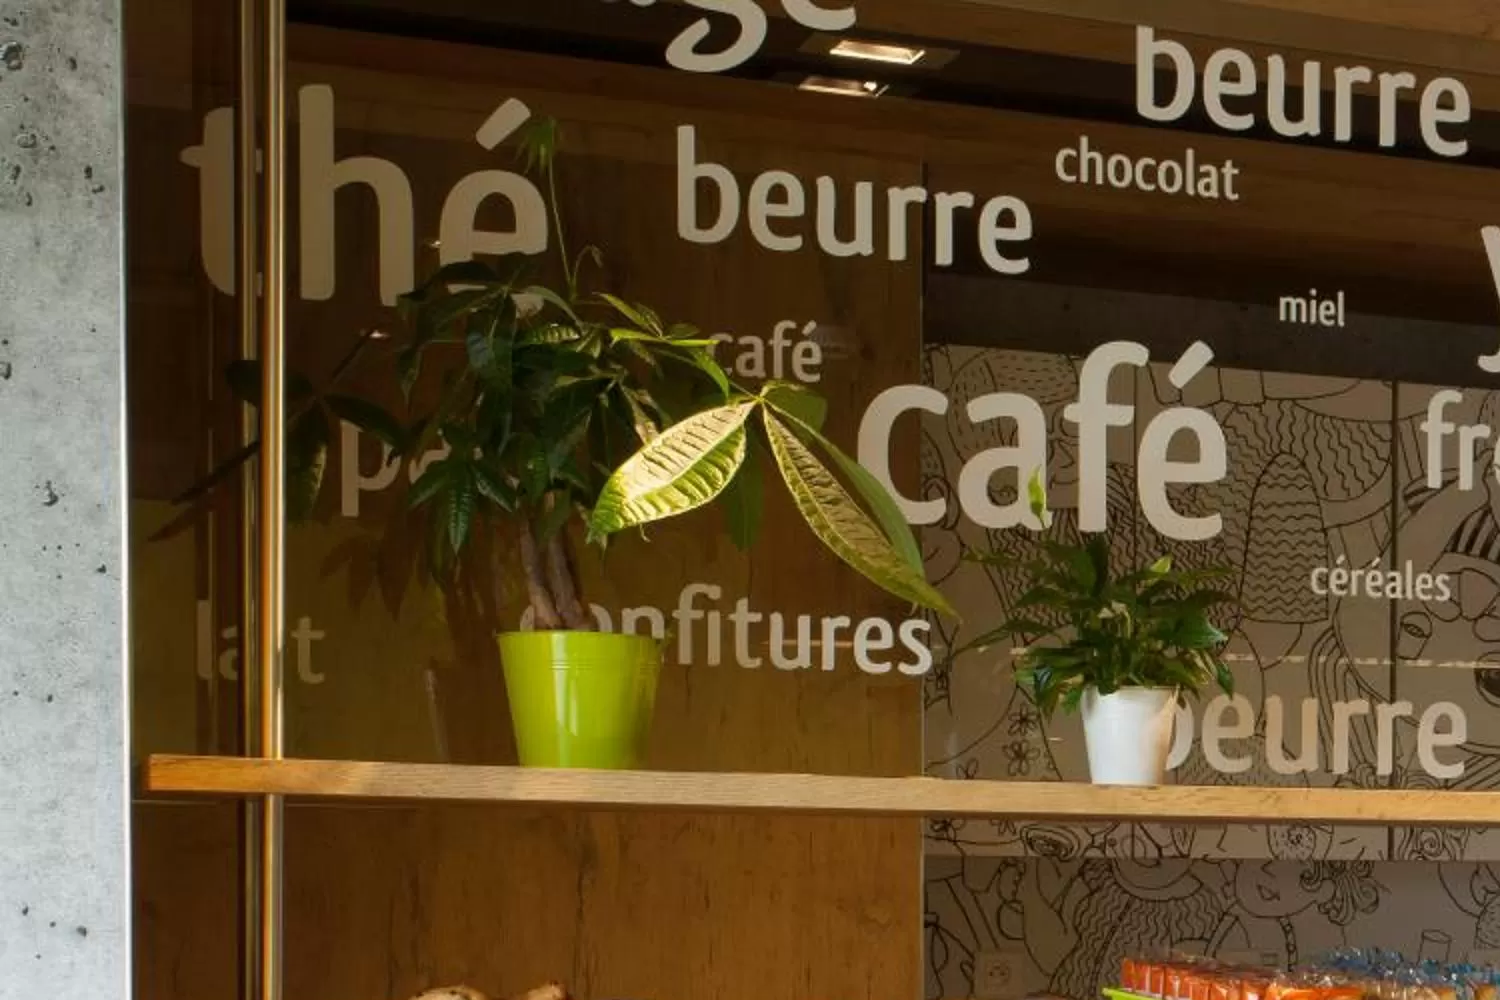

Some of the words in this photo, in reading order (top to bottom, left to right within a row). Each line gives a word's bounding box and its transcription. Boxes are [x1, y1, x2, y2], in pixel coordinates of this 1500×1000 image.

[1134, 25, 1471, 156] beurre
[676, 125, 1033, 274] beurre
[1055, 136, 1239, 200] chocolat
[1279, 289, 1345, 327] miel
[856, 341, 1227, 541] café
[1311, 558, 1450, 602] céréales
